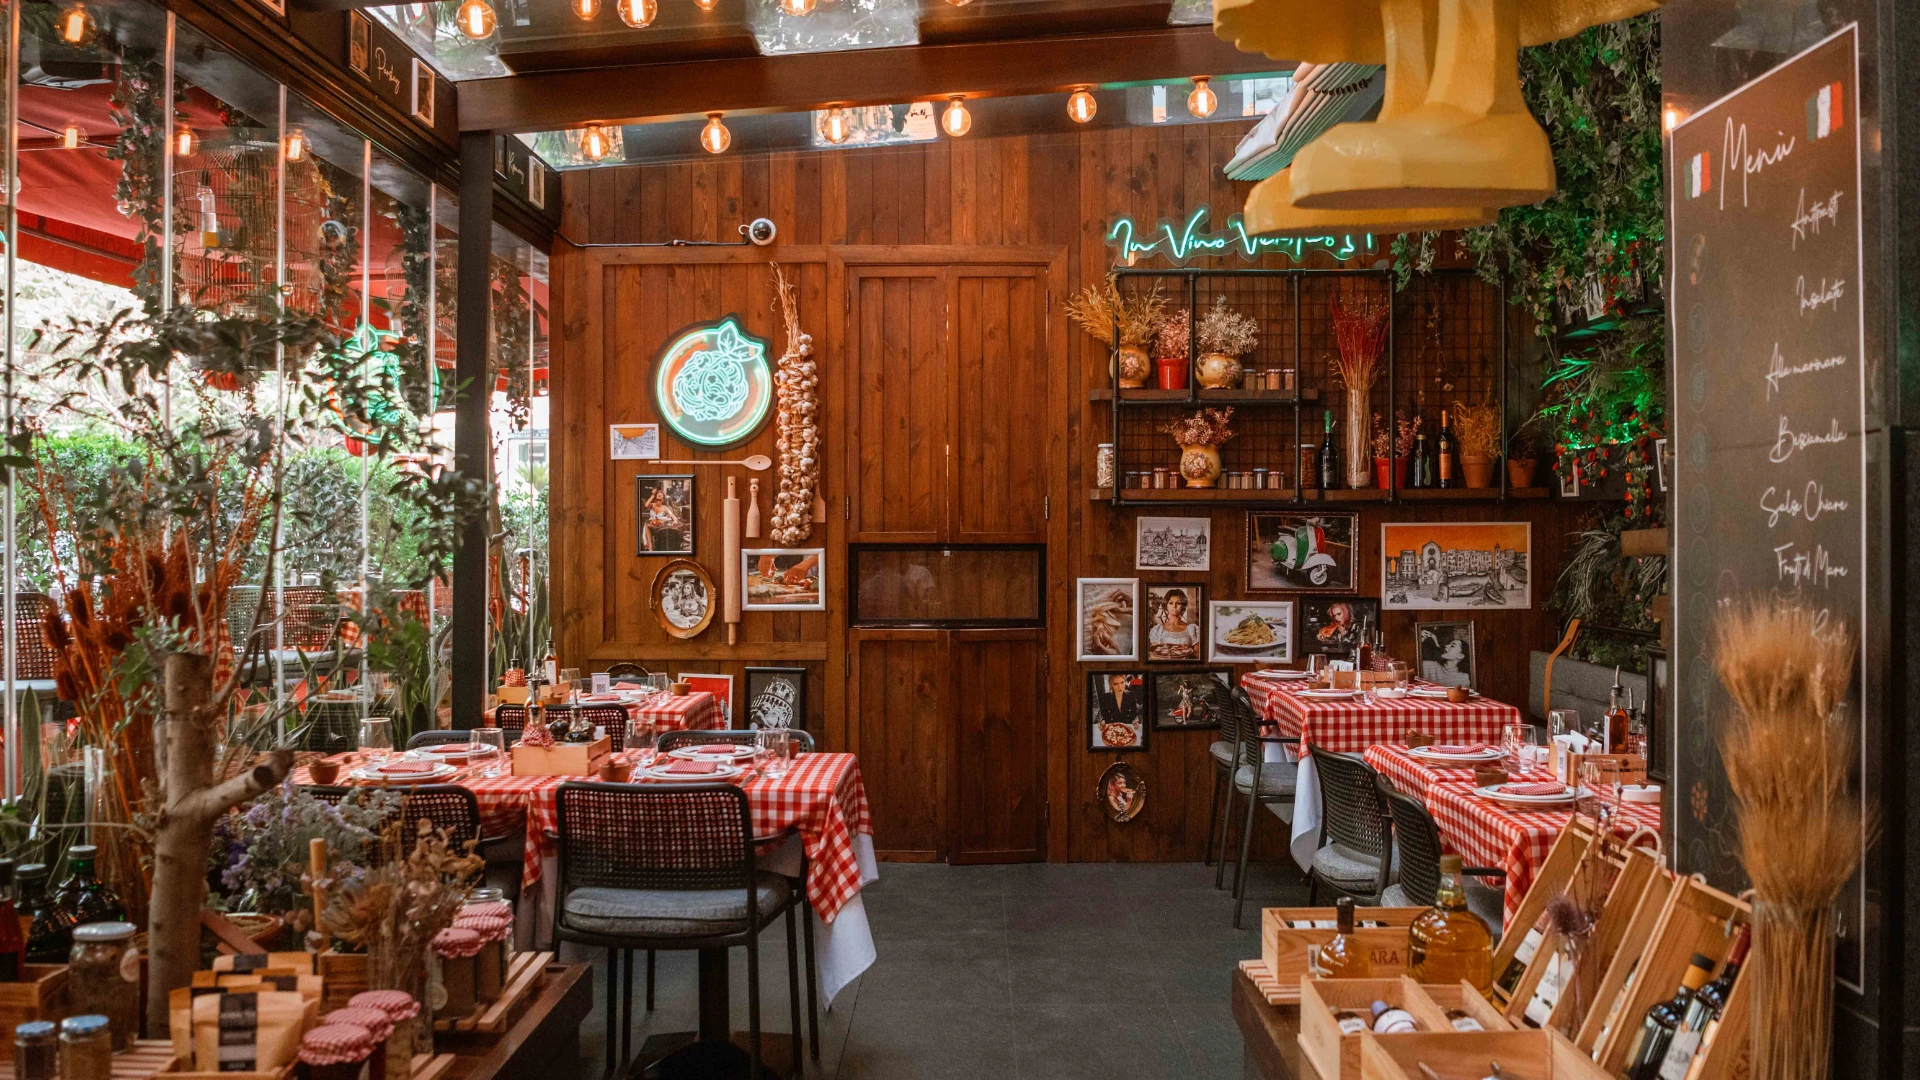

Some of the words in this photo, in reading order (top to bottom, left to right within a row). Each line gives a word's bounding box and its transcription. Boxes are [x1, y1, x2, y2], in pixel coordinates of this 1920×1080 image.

[1112, 218, 1155, 260] In
[1164, 208, 1226, 259] Vino
[1813, 544, 1848, 589] Mare
